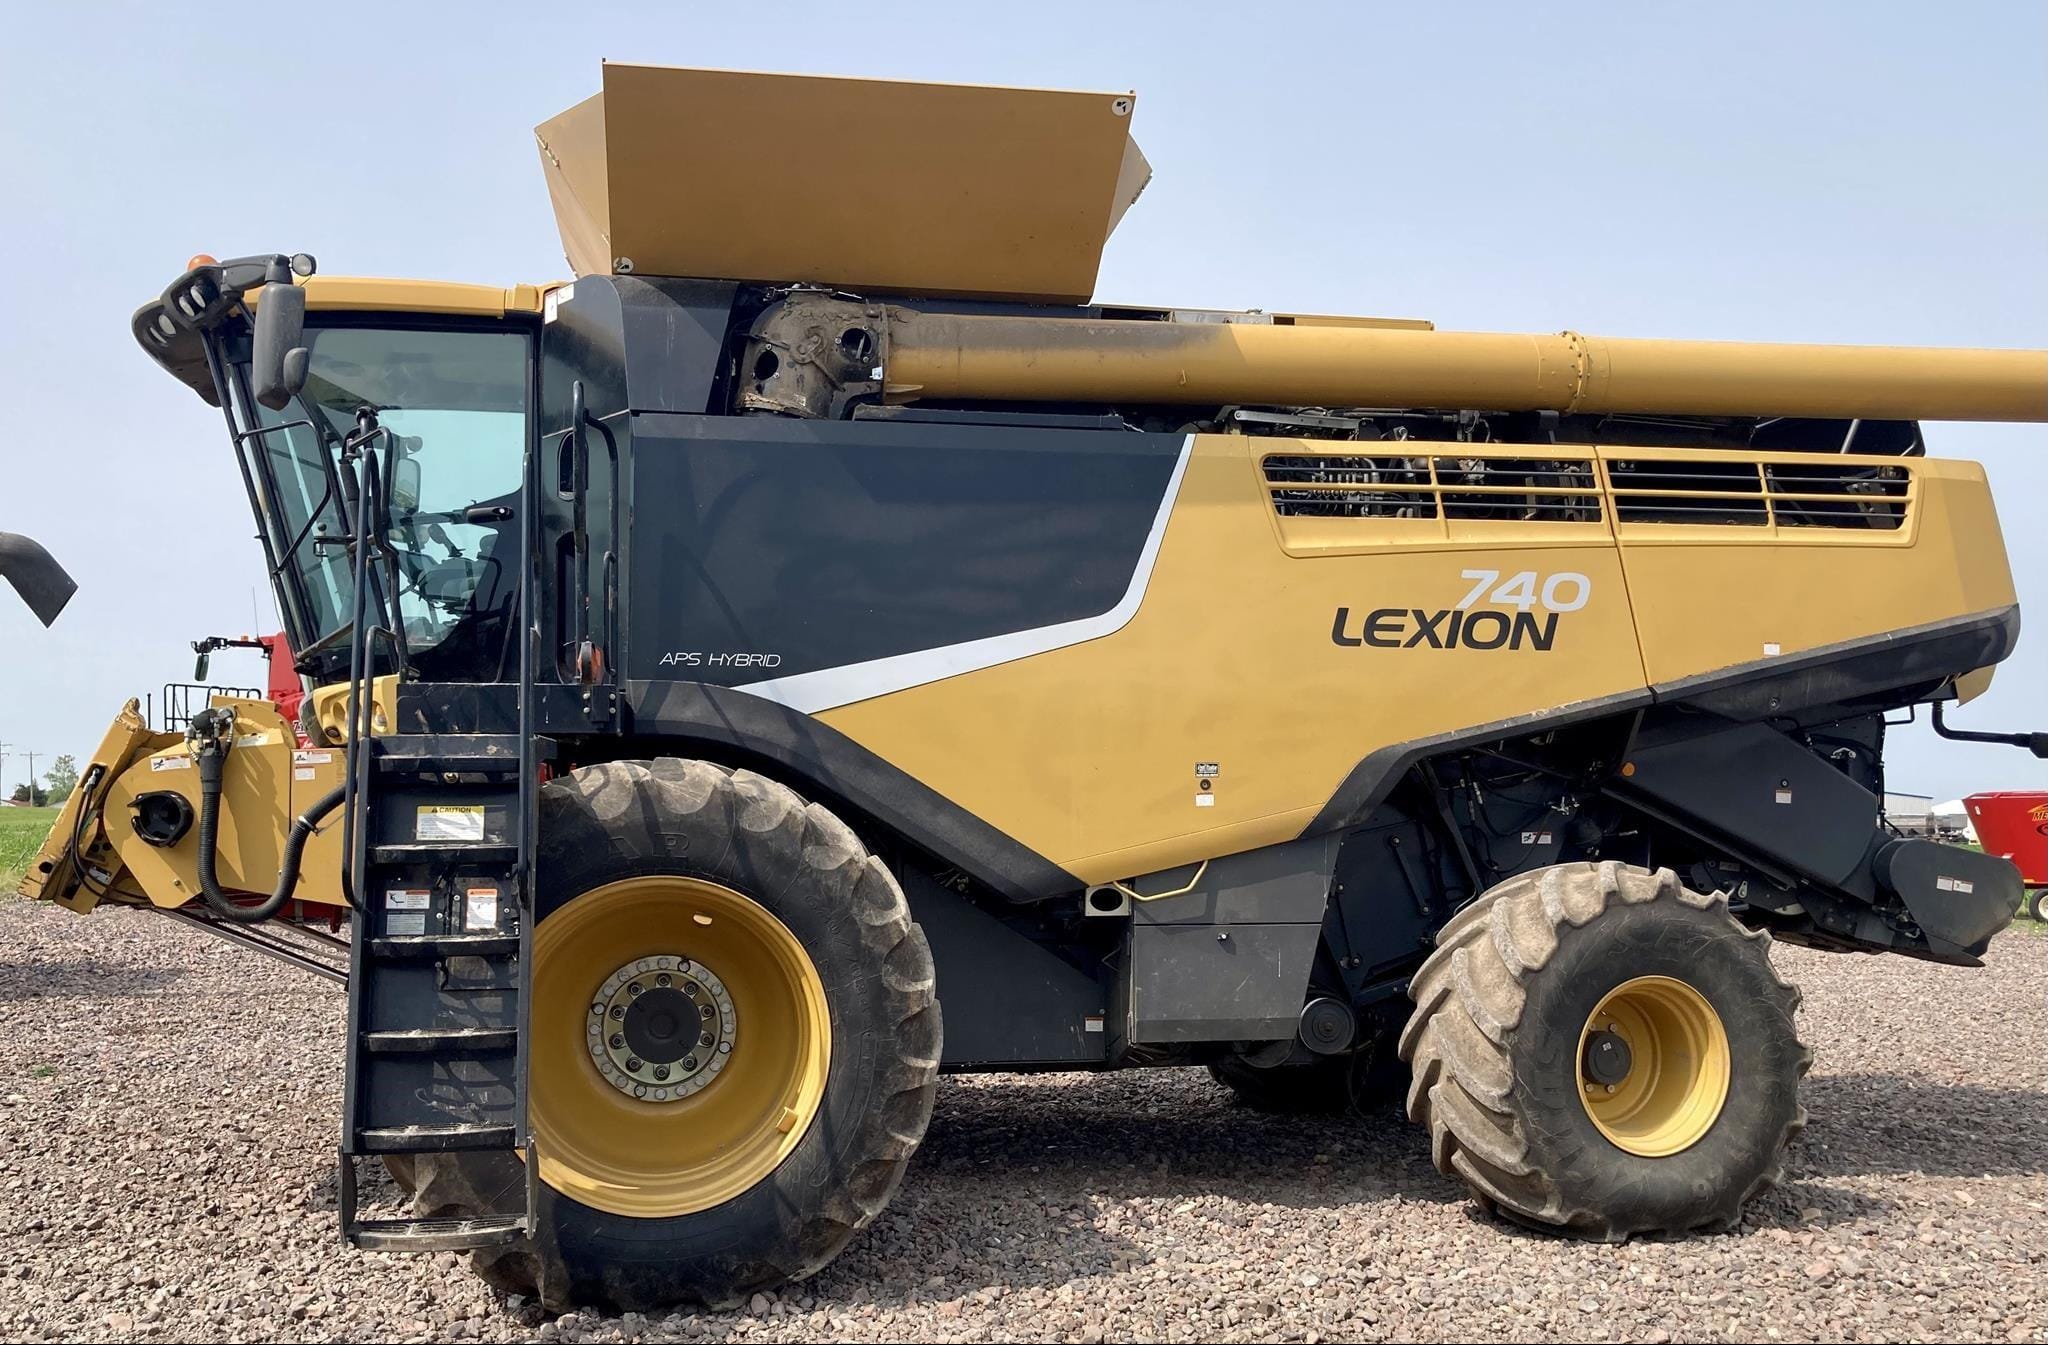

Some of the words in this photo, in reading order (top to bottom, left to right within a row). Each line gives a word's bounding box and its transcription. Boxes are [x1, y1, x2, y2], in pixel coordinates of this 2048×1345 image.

[1455, 569, 1591, 612] 740
[1331, 607, 1559, 651] LEXION
[658, 652, 702, 666] APS
[708, 652, 781, 667] HYBRID
[439, 806, 472, 814] CAUTION
